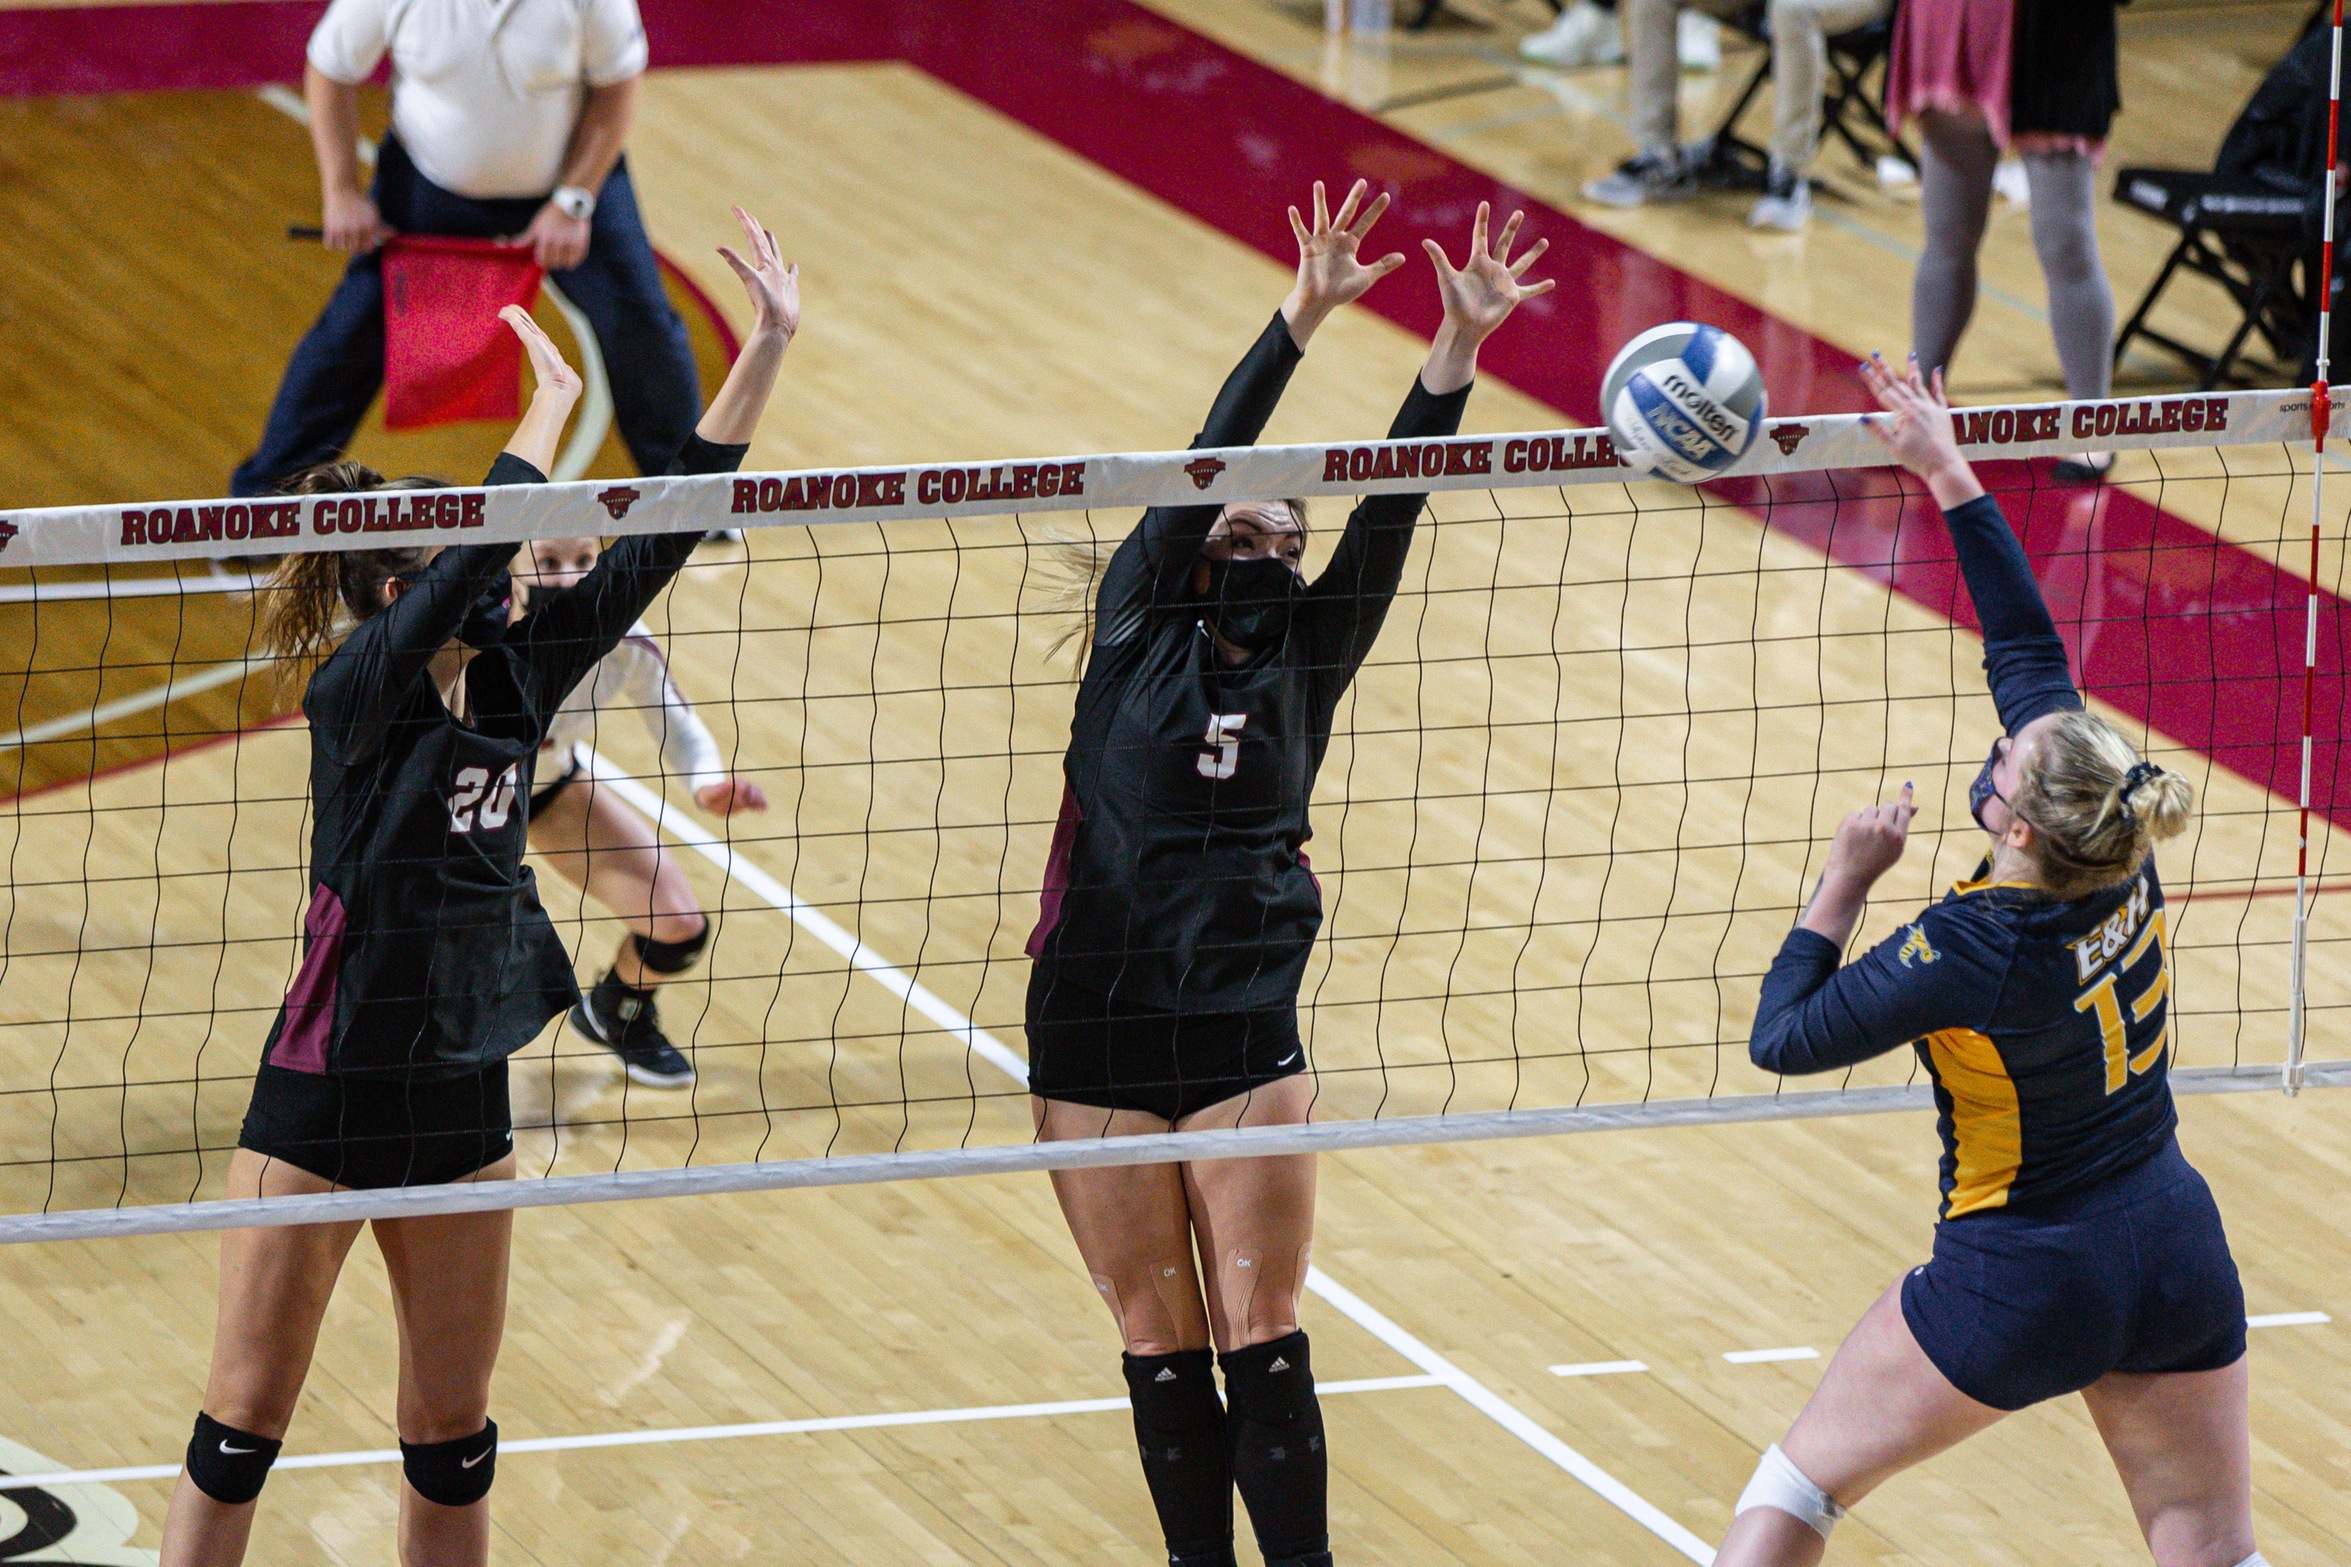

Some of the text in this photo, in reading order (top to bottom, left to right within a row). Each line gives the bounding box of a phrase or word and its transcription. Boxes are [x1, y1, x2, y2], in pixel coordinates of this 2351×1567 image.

[1645, 401, 1719, 461] NCAA
[1662, 375, 1739, 441] molten
[1951, 398, 2229, 446] ANOKE COLLEGE
[731, 462, 1086, 513] ROANOKE COLLEGE
[1322, 441, 1493, 482] ROANOKE
[1504, 434, 1633, 473] COLLE
[121, 493, 486, 545] ROANOKE COLLEGE
[1195, 712, 1248, 781] 5
[447, 762, 518, 834] 20
[2073, 908, 2169, 1097] 13
